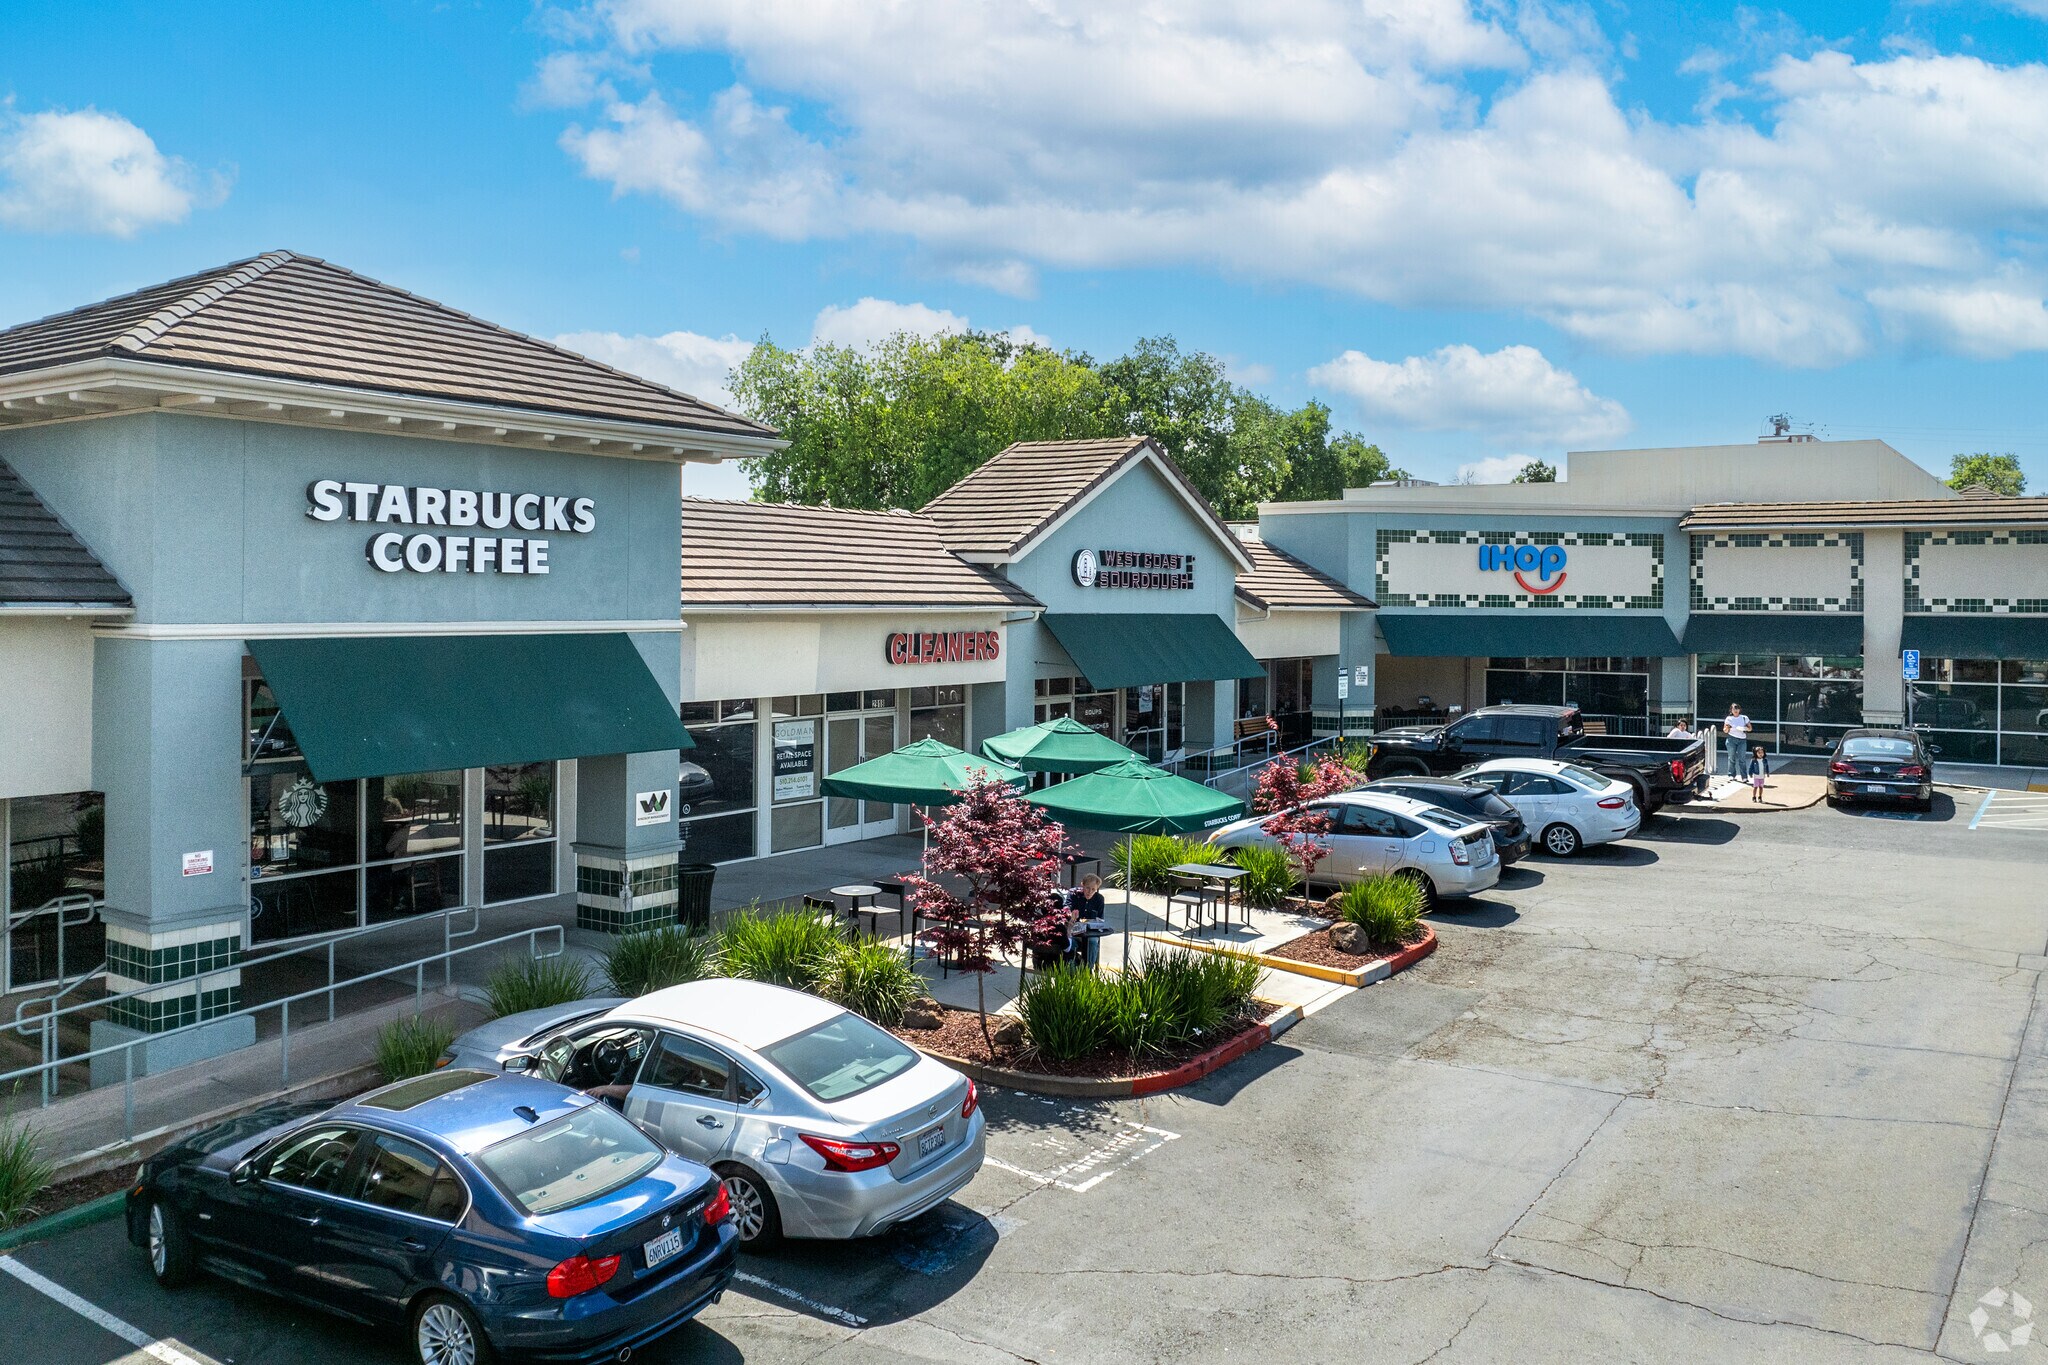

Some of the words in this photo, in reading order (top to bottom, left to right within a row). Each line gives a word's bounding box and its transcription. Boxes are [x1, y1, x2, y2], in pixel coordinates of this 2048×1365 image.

[306, 479, 596, 533] STARBUCKS
[366, 532, 550, 574] COFFEE
[1100, 550, 1141, 567] WEST
[1142, 553, 1184, 569] COAST
[1479, 545, 1567, 581] IHOP
[1097, 570, 1189, 590] SOURDOUGH
[886, 631, 1000, 665] CLEANERS
[1084, 708, 1102, 716] SOUPS
[775, 727, 814, 738] GOLDMAN
[776, 752, 795, 761] RETAIL
[794, 750, 812, 759] SPACE
[779, 759, 808, 770] AVAILABLE
[1204, 816, 1228, 827] STARBUCKS
[649, 1235, 680, 1262] 6NRV115
